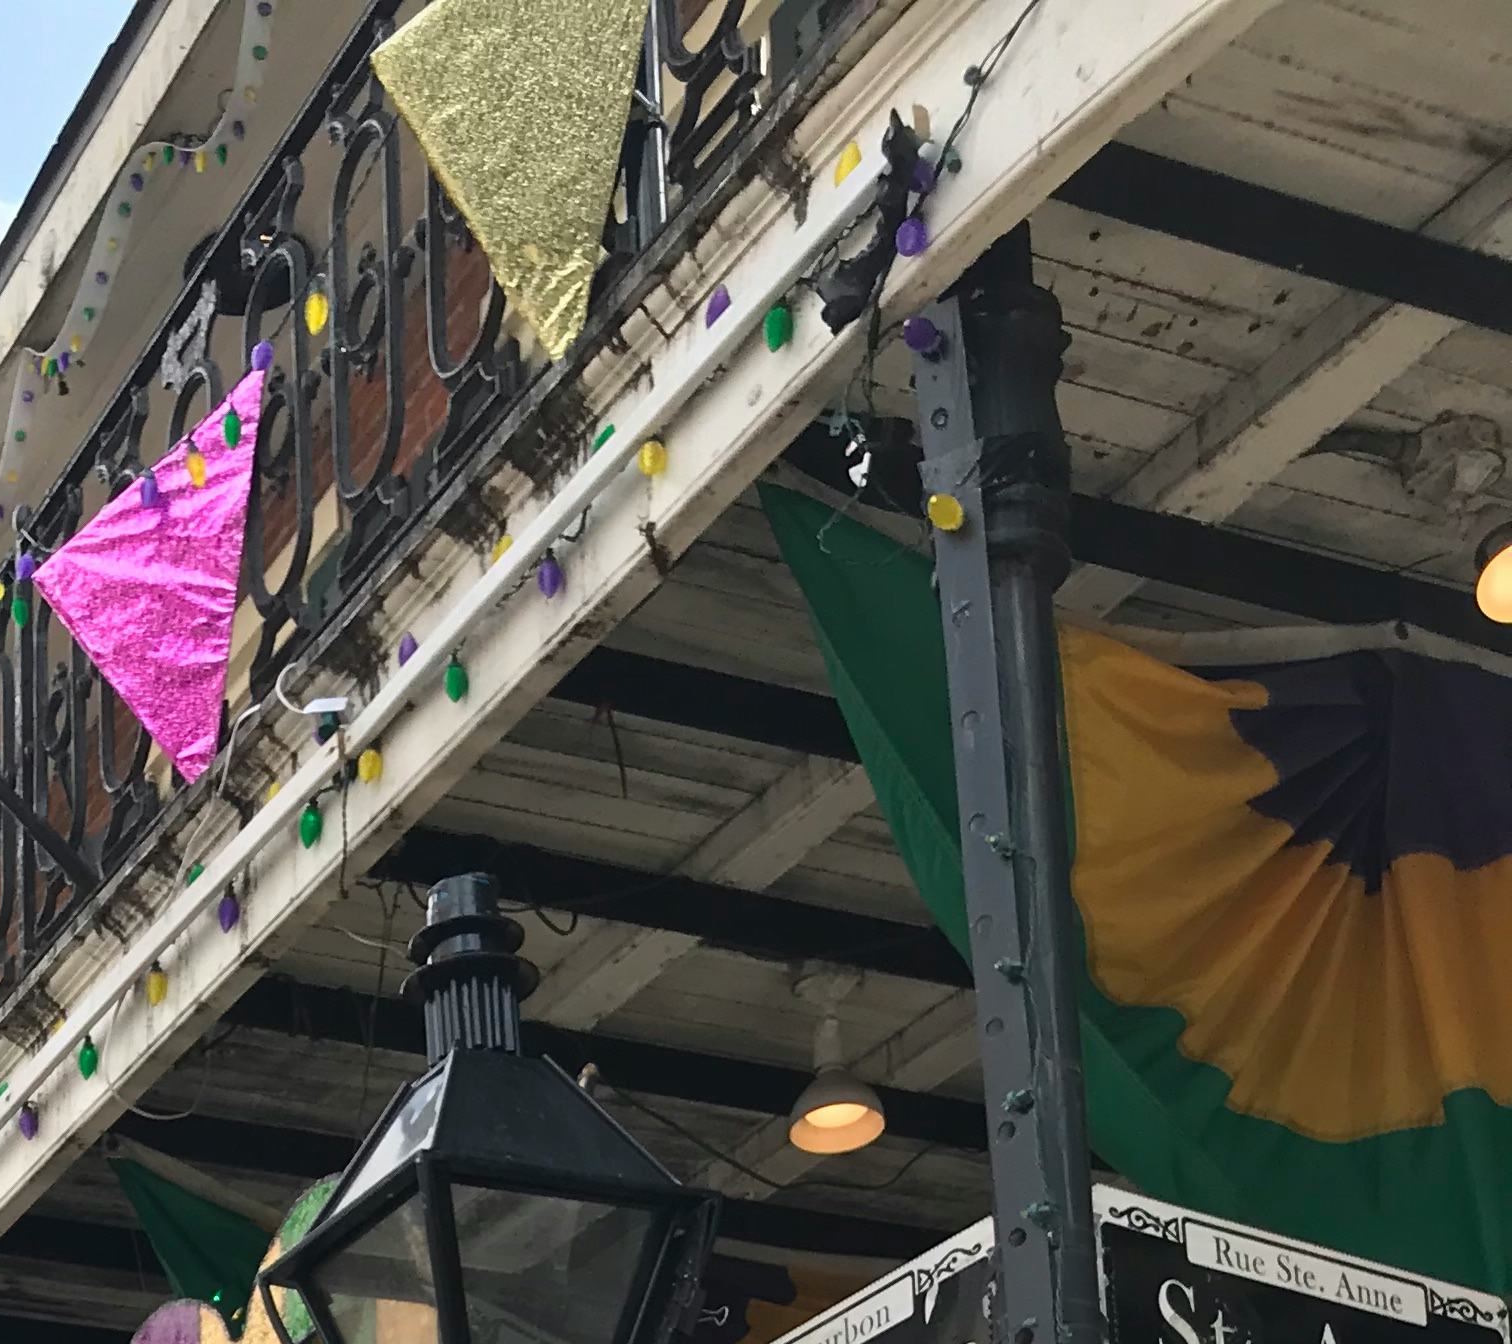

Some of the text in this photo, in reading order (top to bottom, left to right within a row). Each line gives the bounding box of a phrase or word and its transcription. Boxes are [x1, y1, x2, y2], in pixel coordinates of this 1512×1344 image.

[1212, 1236, 1403, 1314] Rue Ste. Anne
